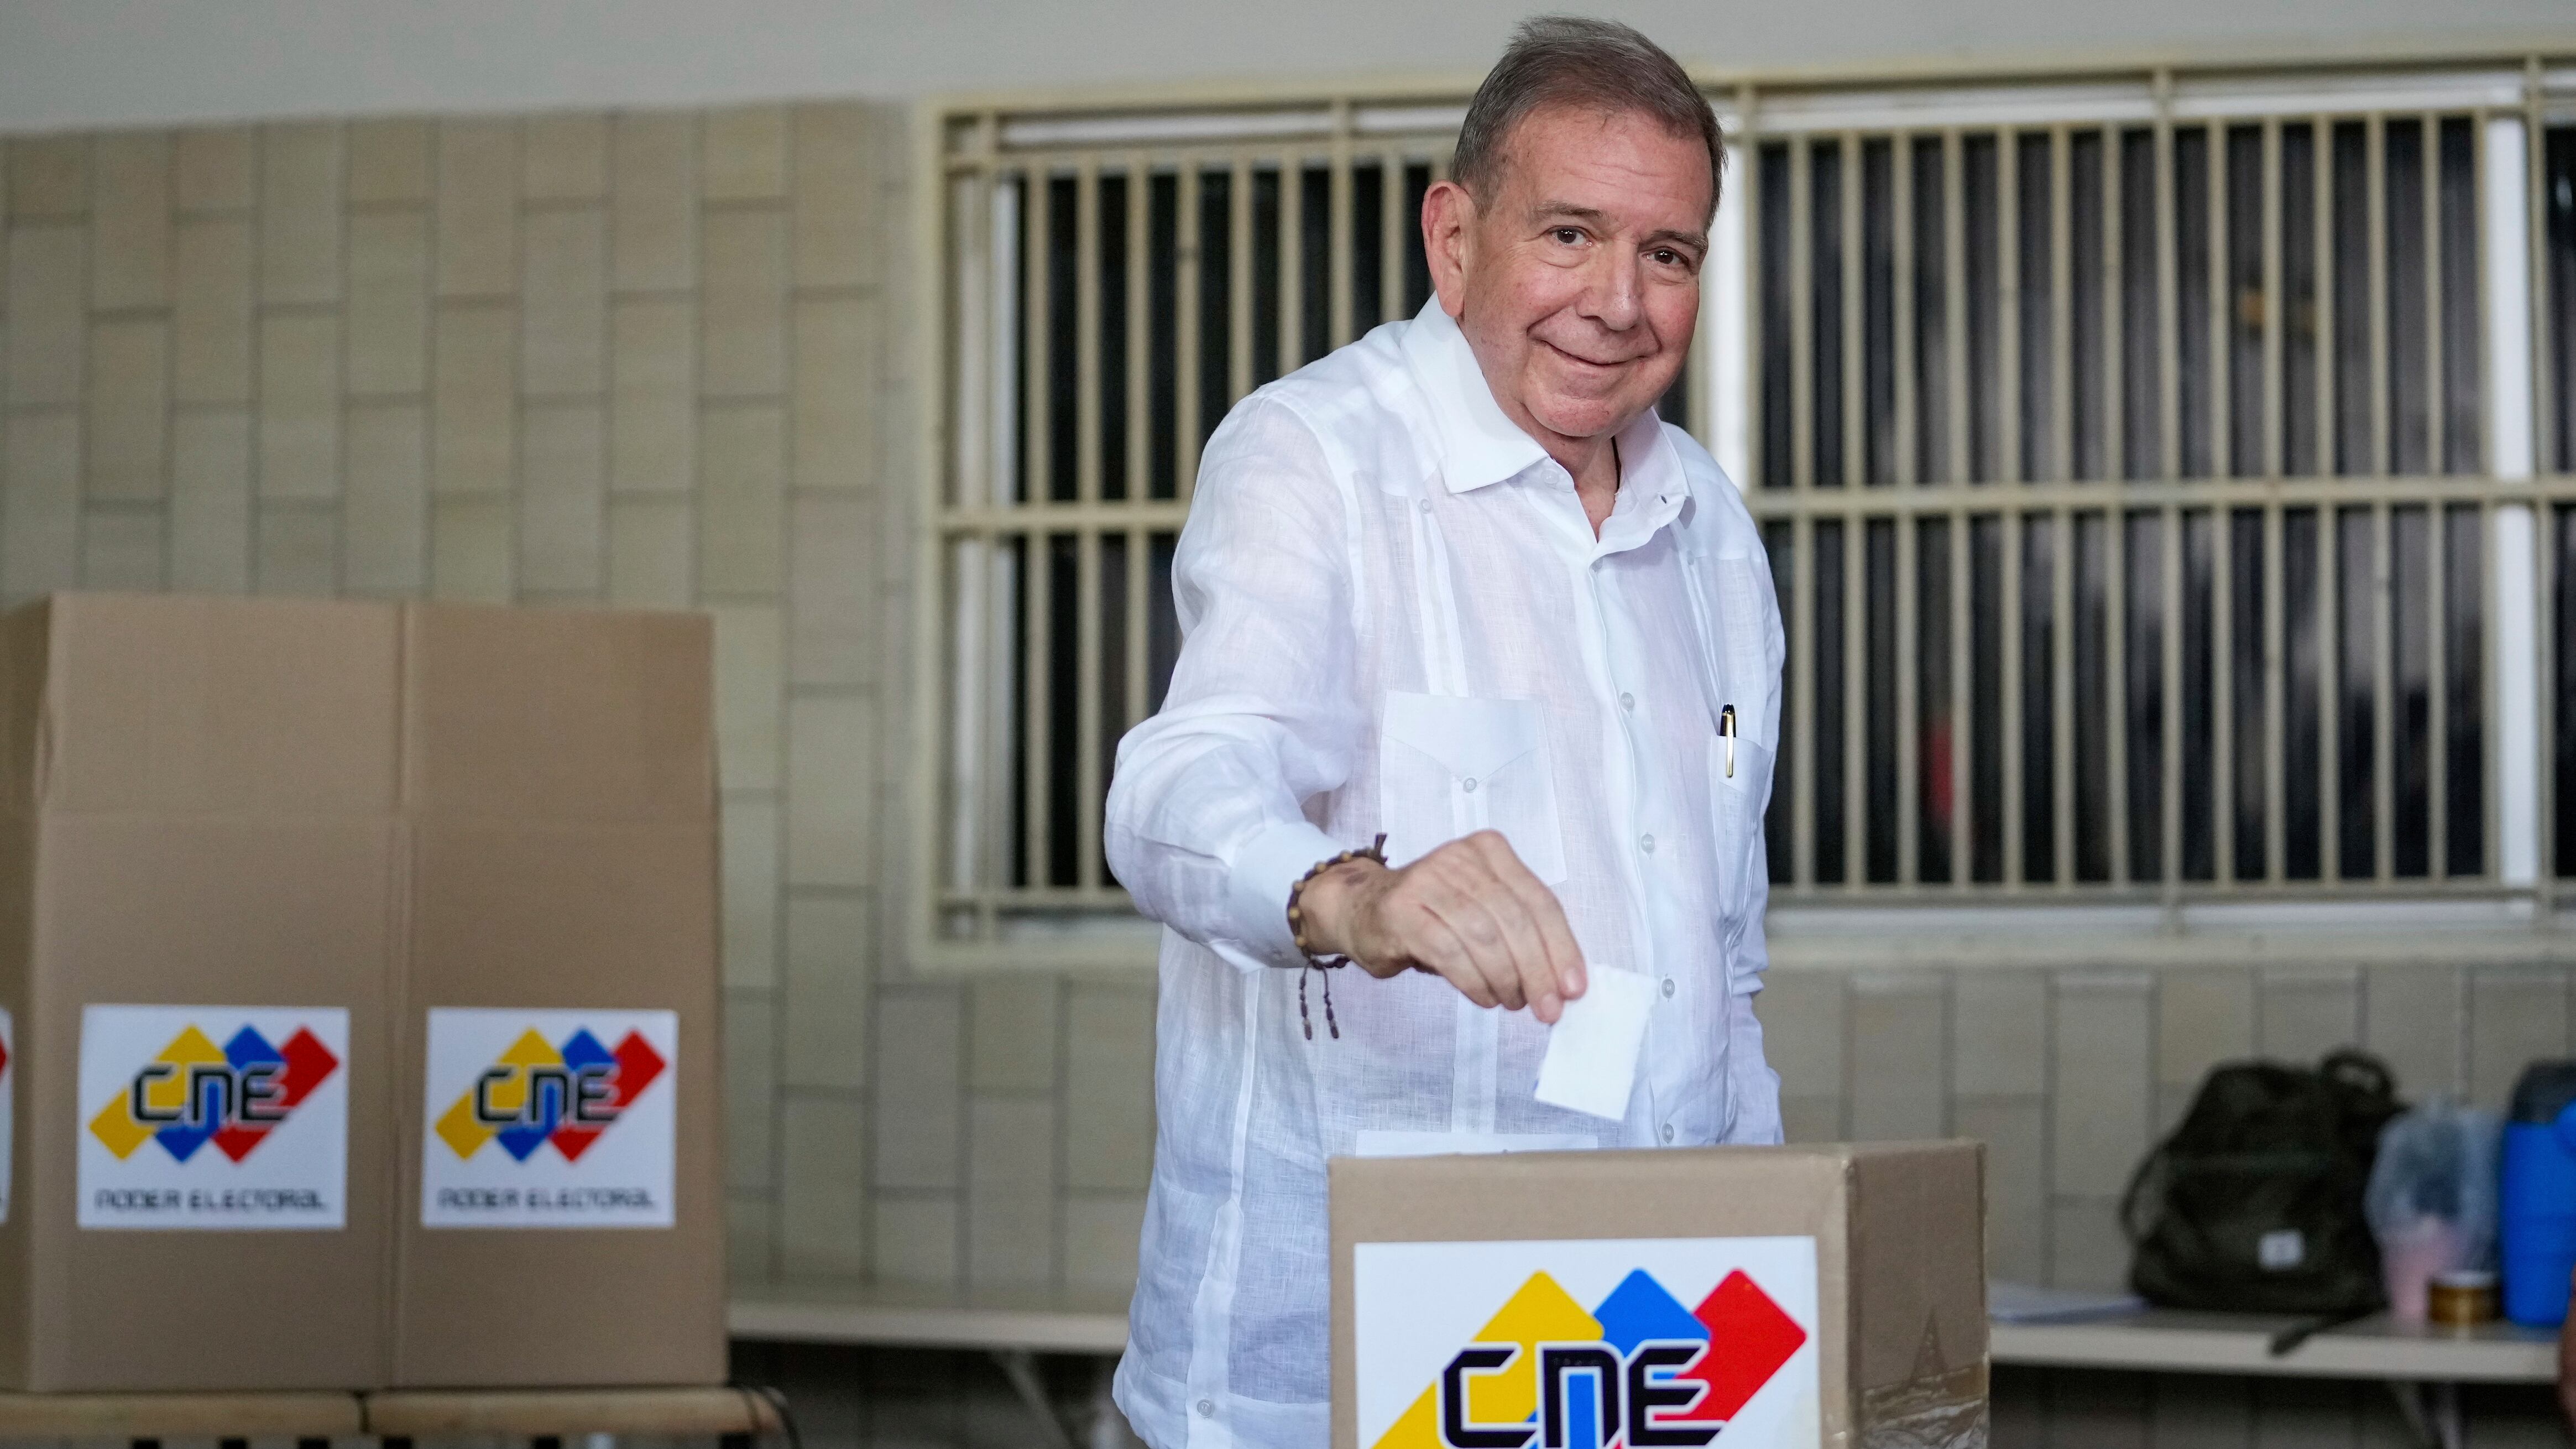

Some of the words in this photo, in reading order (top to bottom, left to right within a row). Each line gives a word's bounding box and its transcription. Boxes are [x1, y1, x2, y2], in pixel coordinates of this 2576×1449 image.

[133, 1065, 288, 1122] CNE
[476, 1067, 618, 1123] CNE
[1443, 1347, 1721, 1449] CNE
